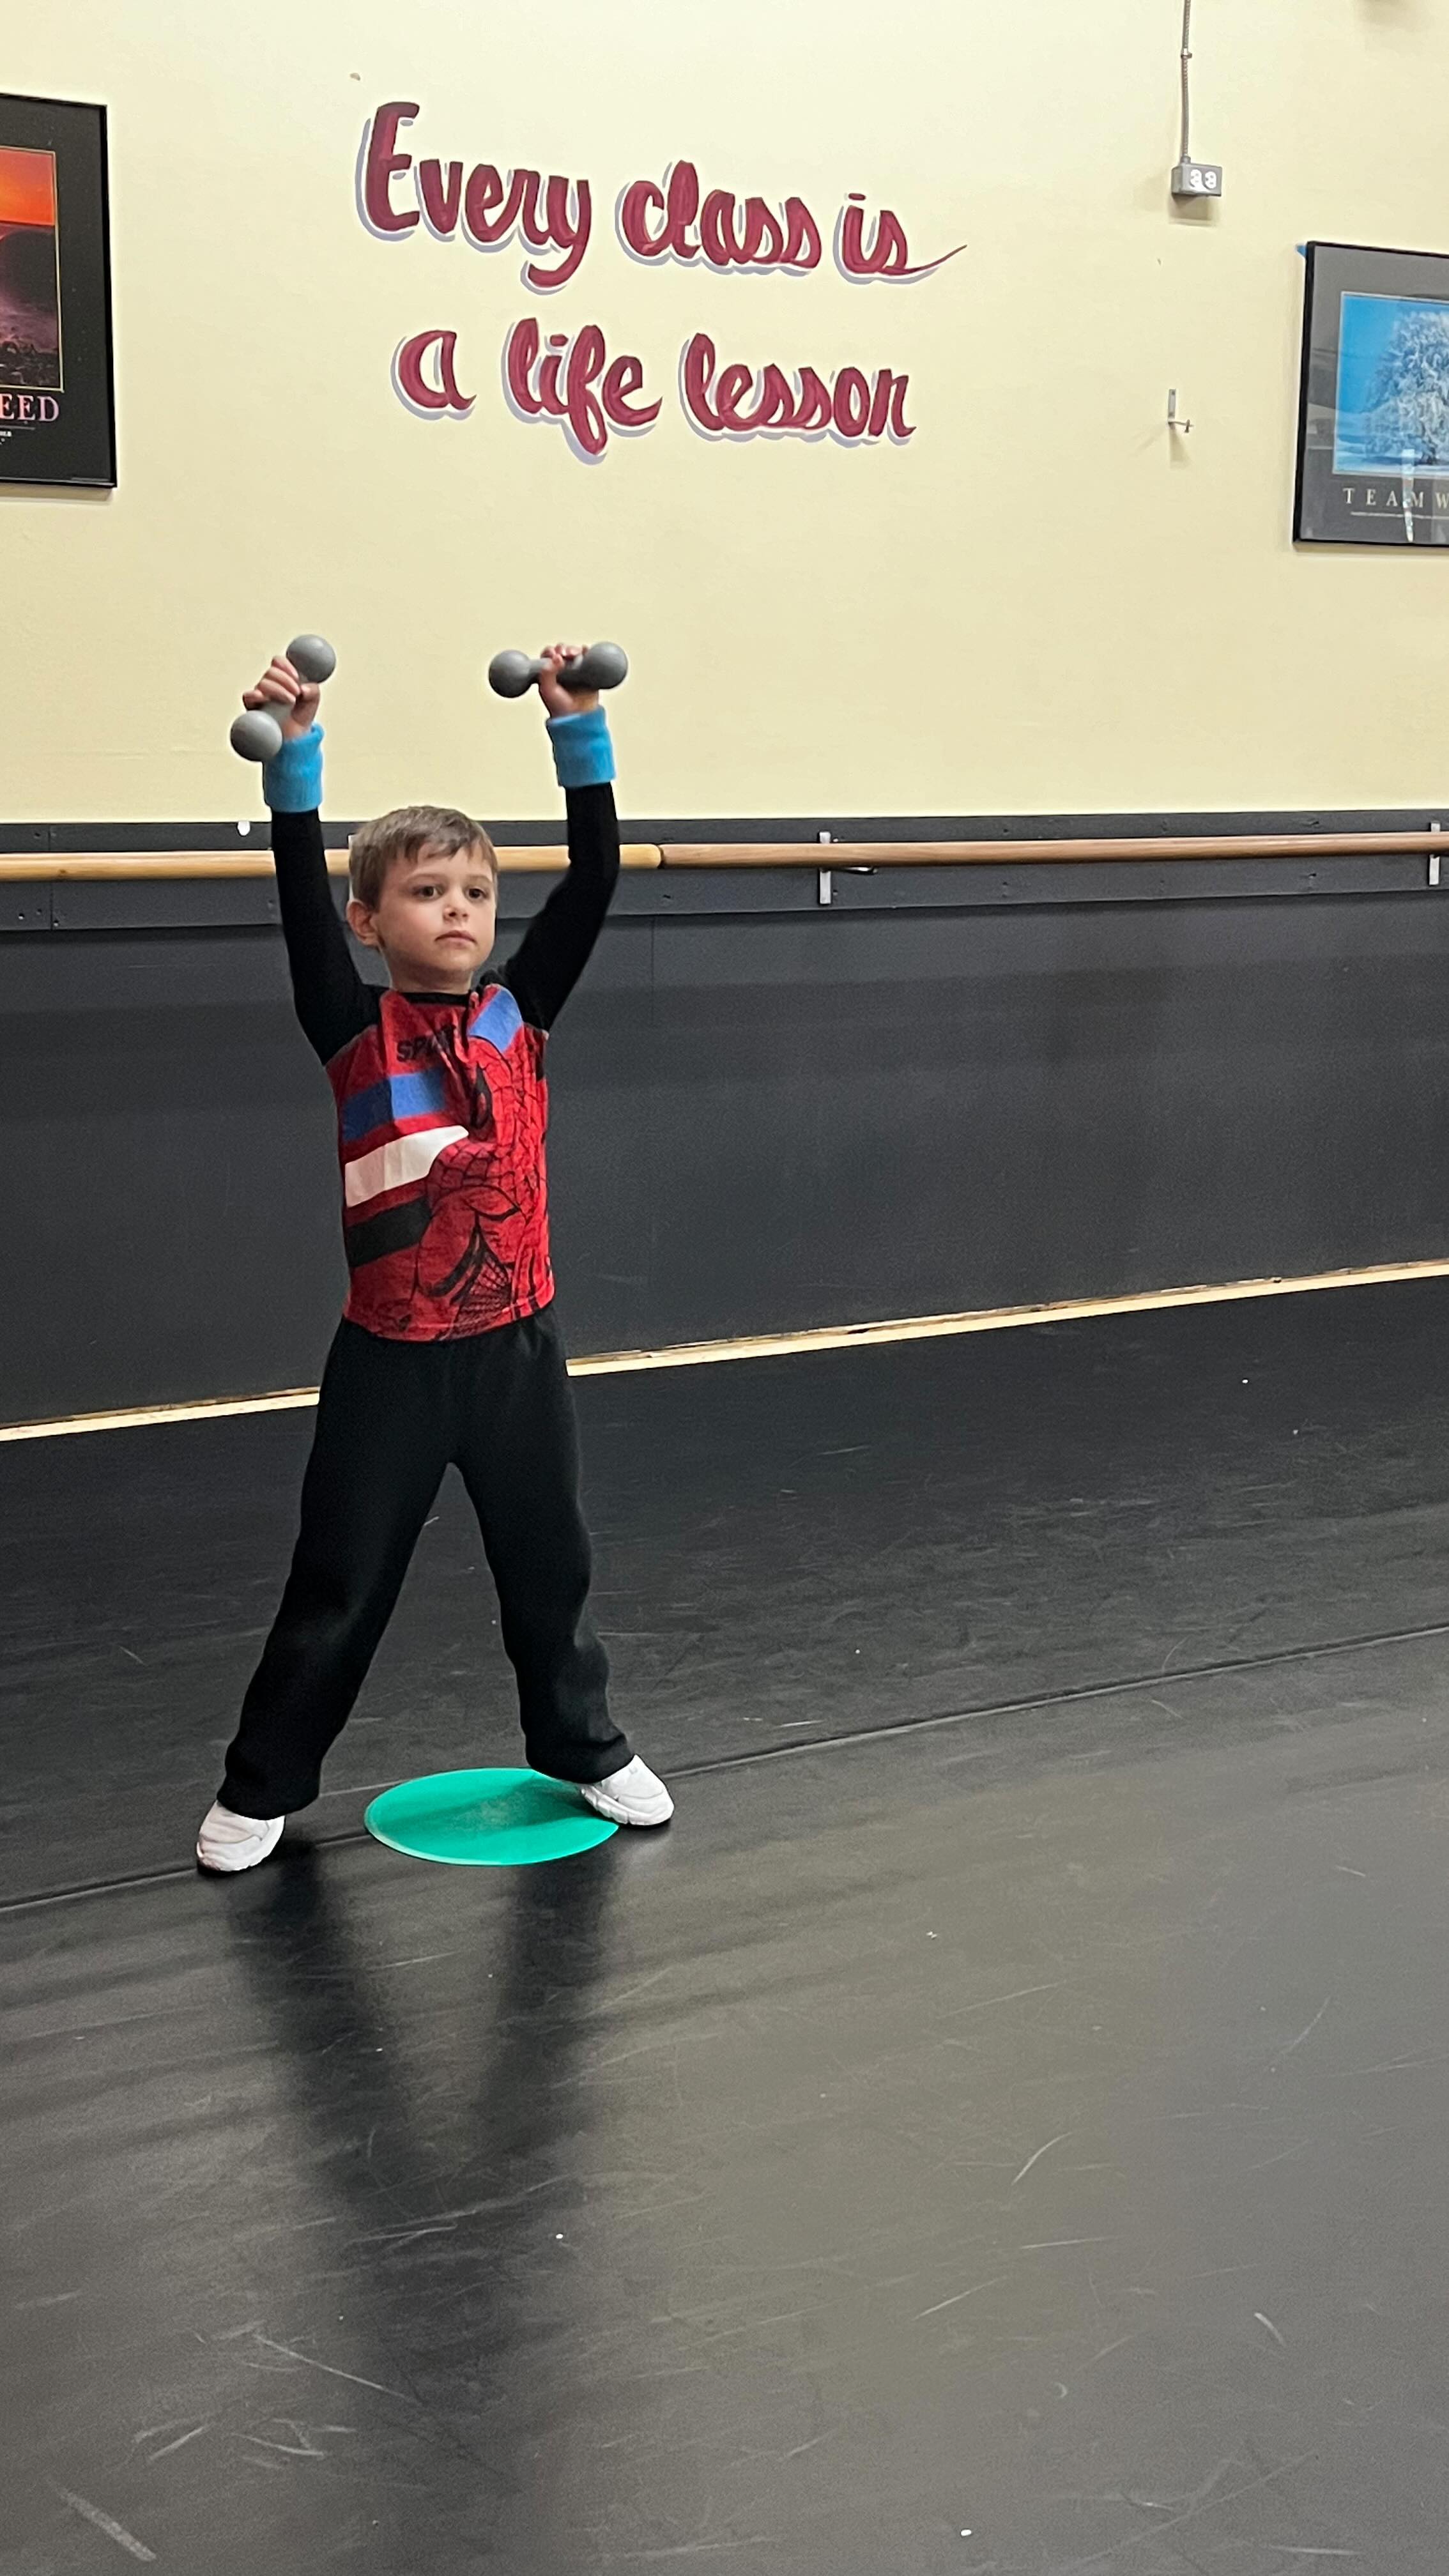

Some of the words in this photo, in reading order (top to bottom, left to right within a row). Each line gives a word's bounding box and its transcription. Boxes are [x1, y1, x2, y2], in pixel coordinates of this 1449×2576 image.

[360, 101, 592, 289] Every
[618, 160, 823, 271] class
[838, 192, 967, 278] is
[395, 330, 476, 412] a
[507, 317, 663, 457] life
[683, 332, 916, 440] lesson
